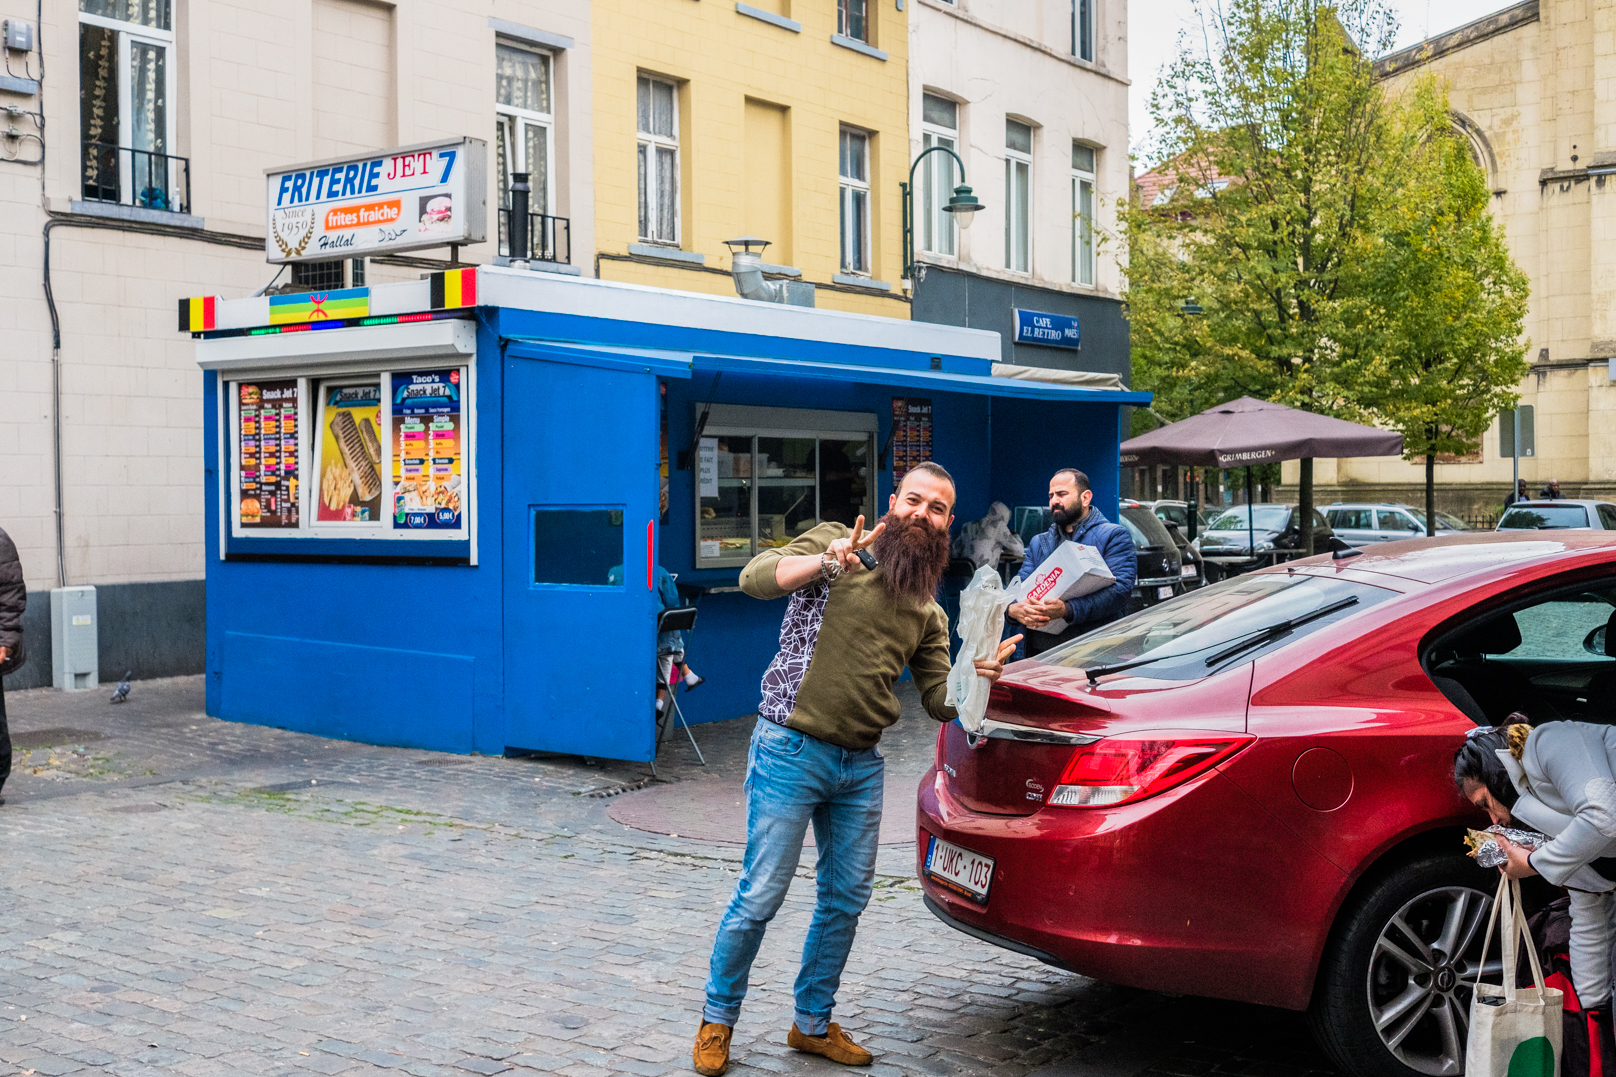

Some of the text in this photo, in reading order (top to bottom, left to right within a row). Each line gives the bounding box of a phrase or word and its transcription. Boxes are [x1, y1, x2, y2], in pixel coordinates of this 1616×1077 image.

[276, 150, 457, 206] FRITERIE JET 7
[282, 207, 307, 218] Since
[328, 205, 398, 228] frites fraiche
[281, 221, 308, 236] 1950
[318, 234, 356, 250] Hallal
[1034, 316, 1052, 328] CAFE
[1023, 326, 1062, 340] EL RETIRO
[1064, 328, 1078, 338] MAES
[412, 374, 440, 383] Taco's
[262, 388, 297, 399] Snack Jet 7
[339, 389, 377, 401] Snack Jet 7
[406, 385, 446, 397] Snack Jet 7
[908, 405, 921, 413] Snack
[1222, 450, 1272, 462] GRIMBERGEN
[1028, 569, 1060, 599] GARDENIA
